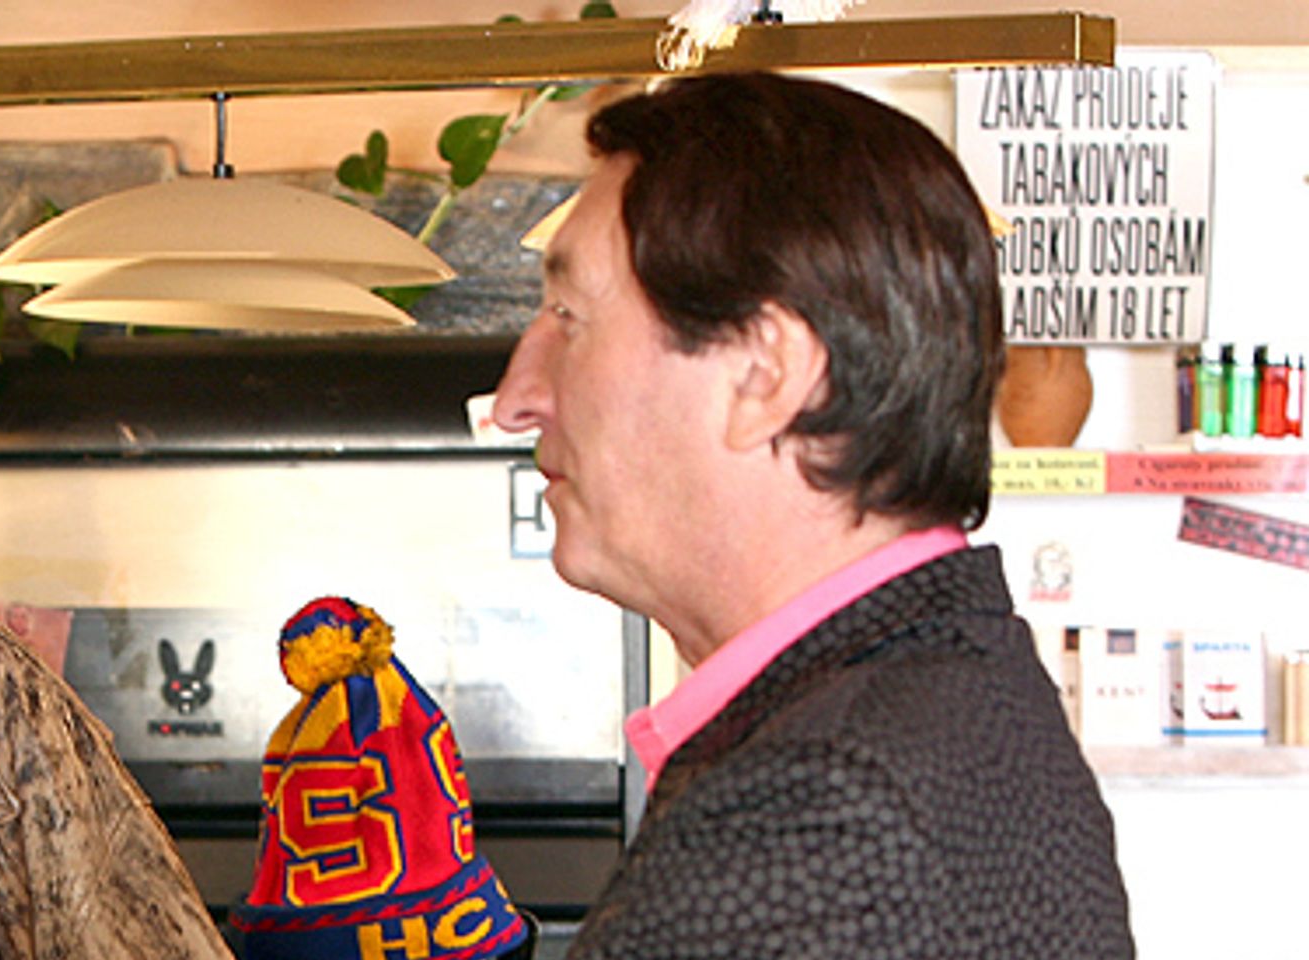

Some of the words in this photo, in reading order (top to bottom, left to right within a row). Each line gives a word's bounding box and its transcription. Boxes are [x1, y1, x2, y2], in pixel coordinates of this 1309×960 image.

[1072, 63, 1189, 130] PRODEJE
[999, 132, 1168, 206] TABÁKOVÝCH
[1091, 208, 1205, 276] OSOBÁM
[1003, 278, 1097, 339] ADŠÍM
[1110, 286, 1138, 339] 18
[1144, 286, 1189, 339] LET
[278, 754, 406, 907] S
